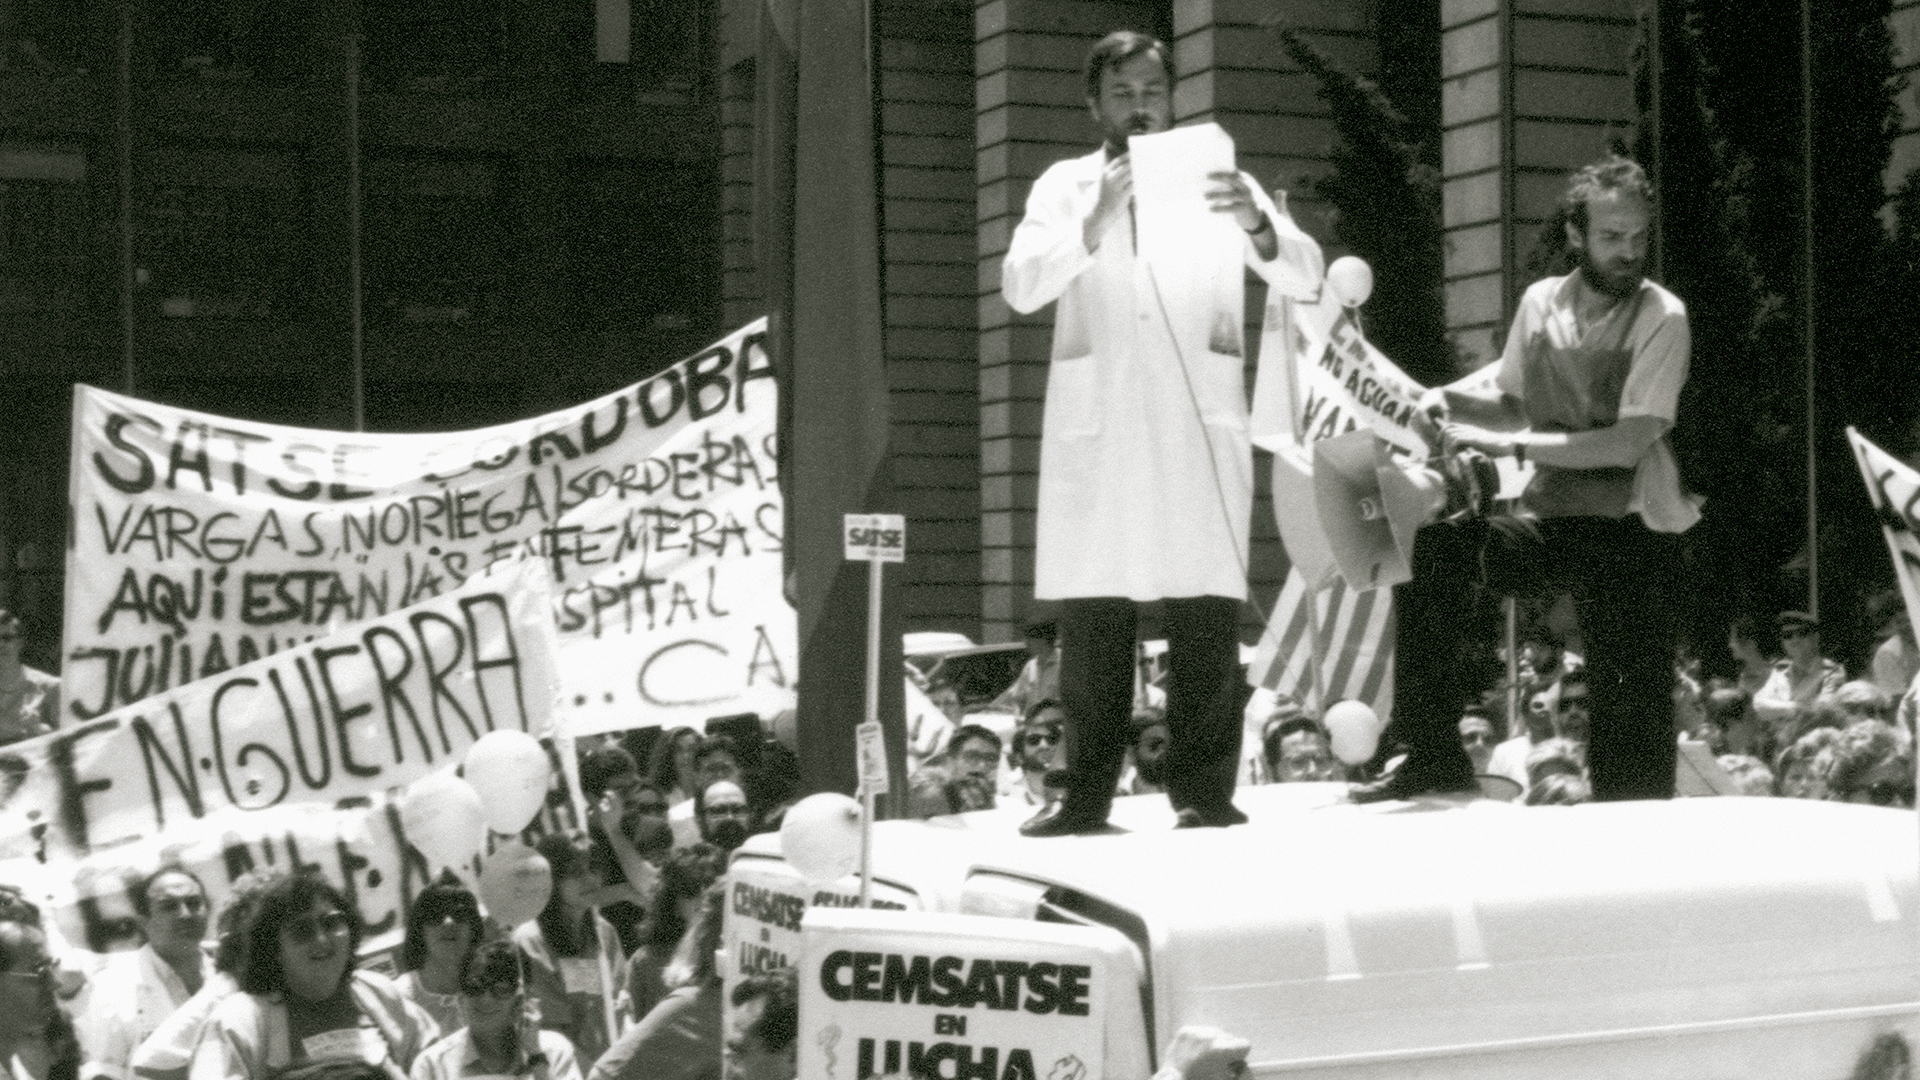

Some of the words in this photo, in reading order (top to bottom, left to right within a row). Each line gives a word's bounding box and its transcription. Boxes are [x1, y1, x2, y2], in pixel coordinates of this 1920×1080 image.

[92, 412, 376, 501] SATSE
[344, 472, 549, 553] NORIEGA
[848, 527, 903, 549] SATSE
[819, 949, 1092, 1017] CEMSATSE
[934, 1013, 967, 1036] EN
[856, 1037, 1037, 1080] LUCHA
